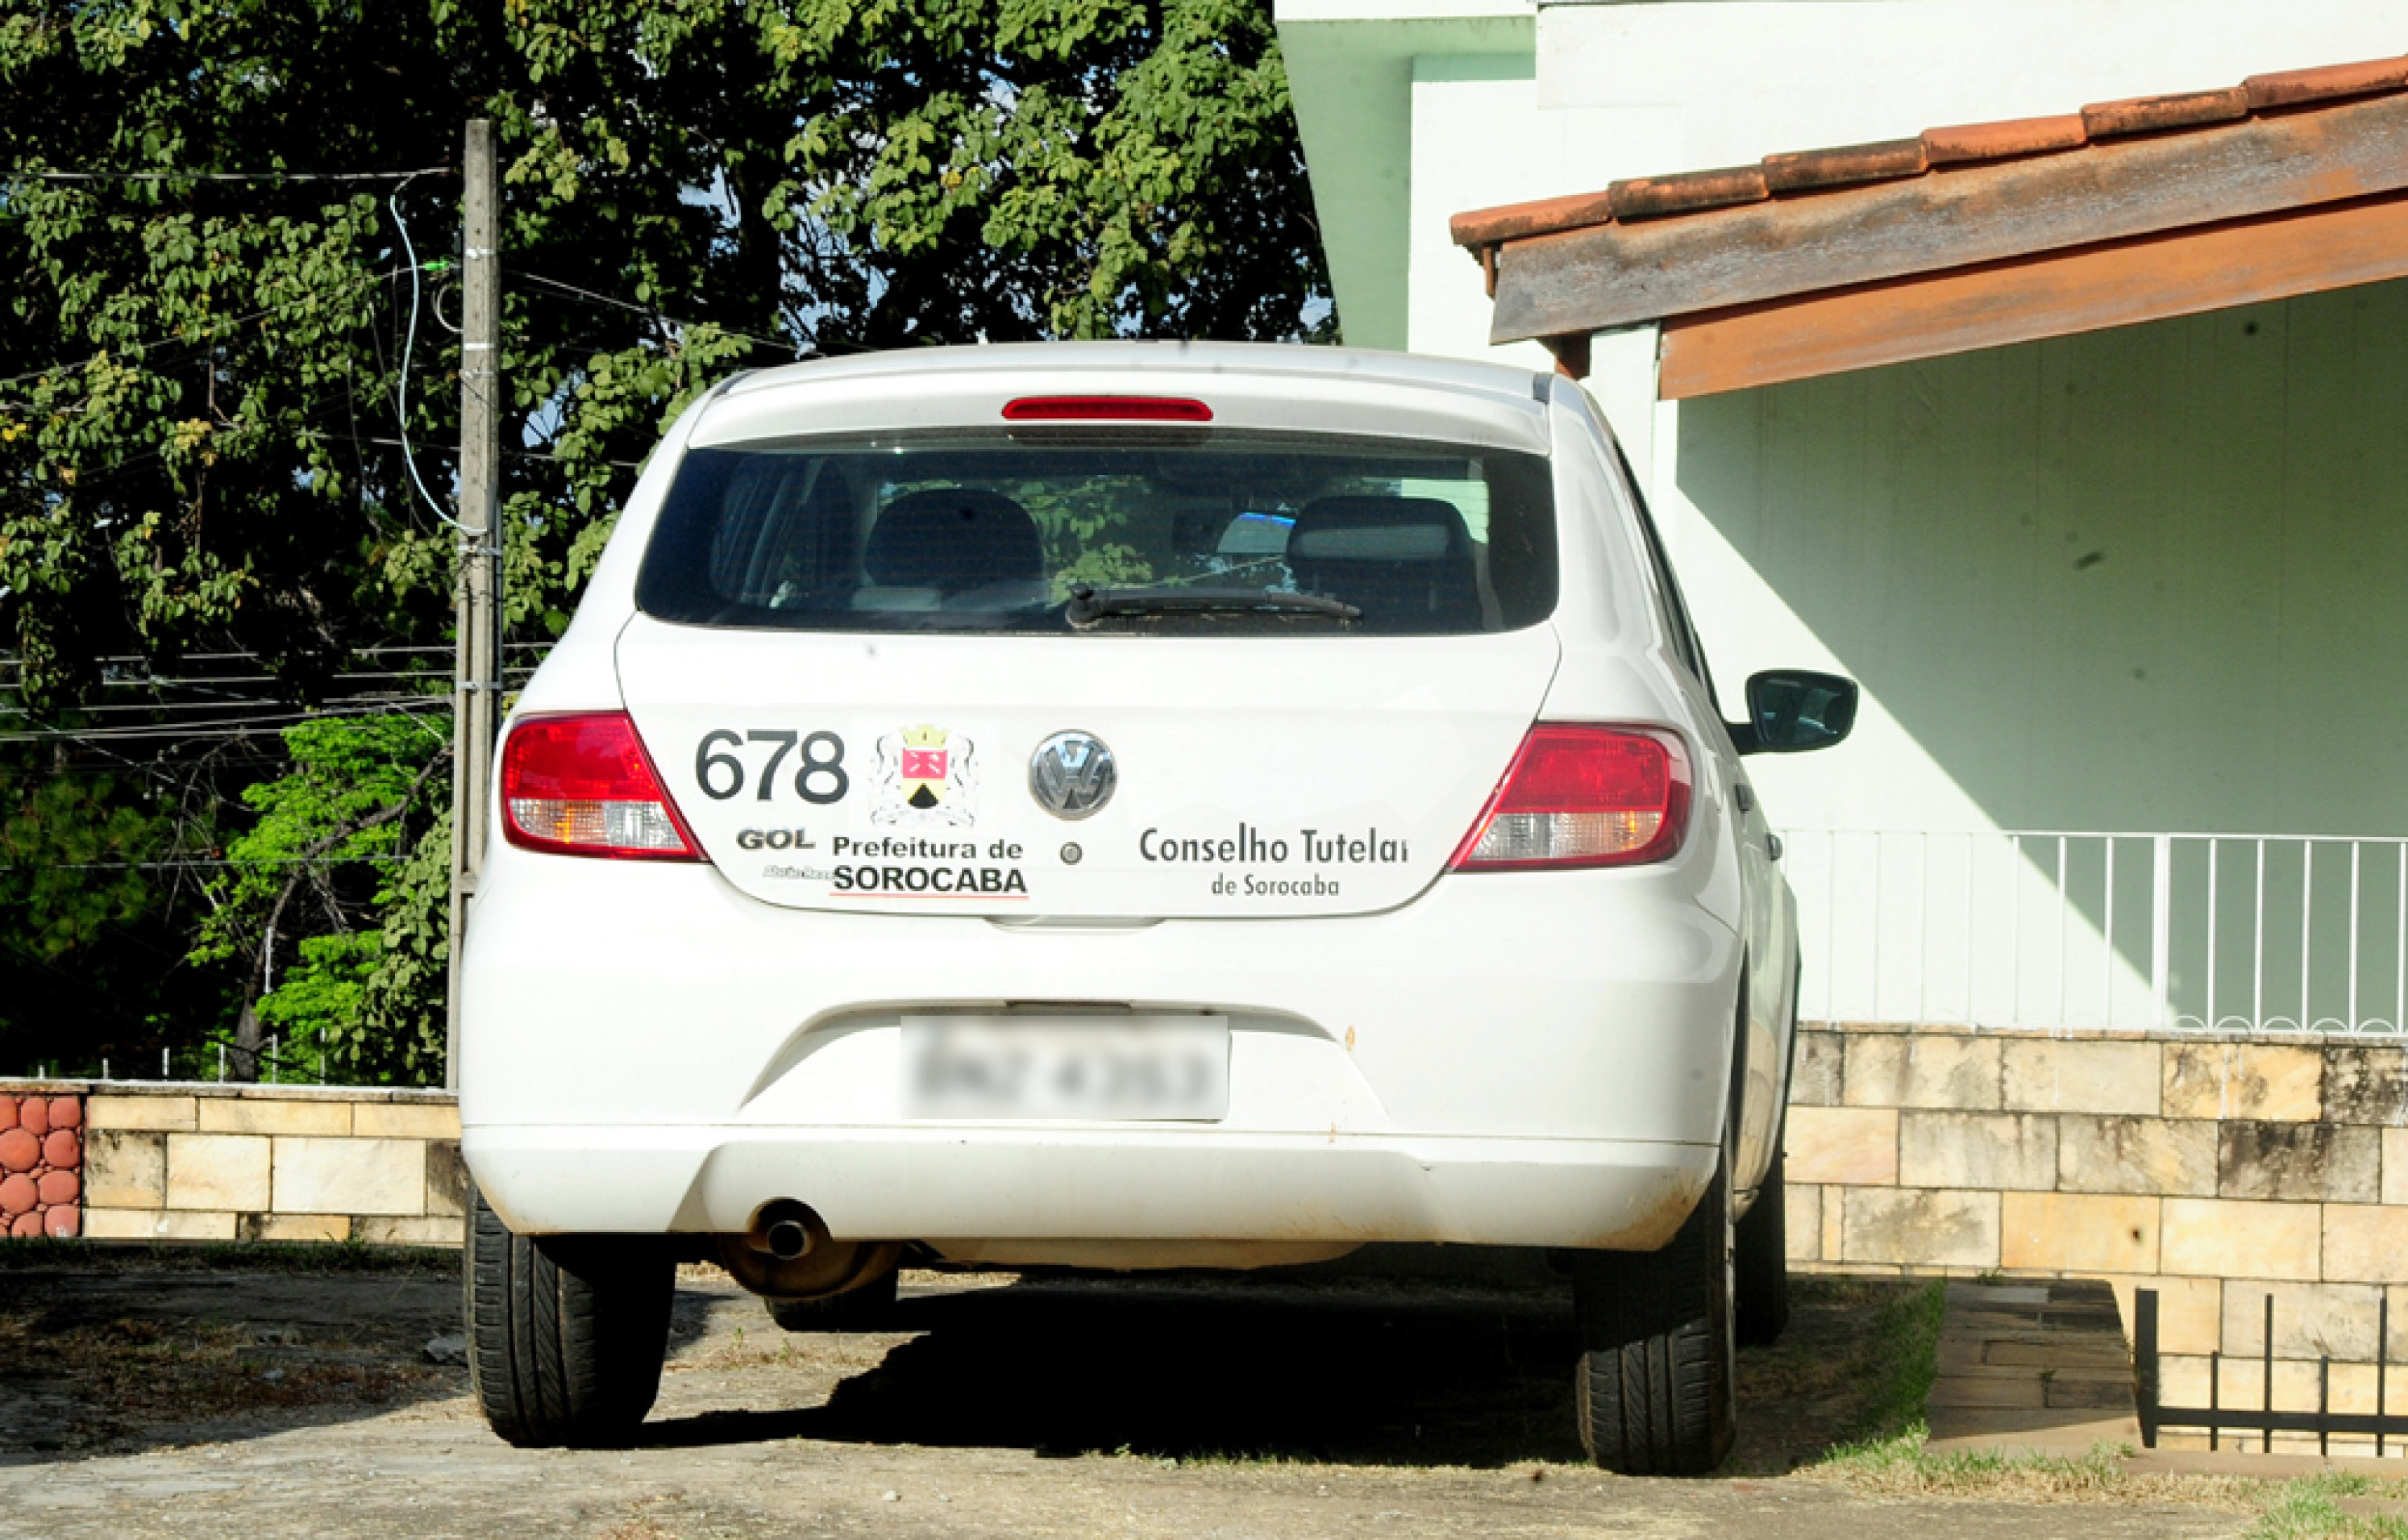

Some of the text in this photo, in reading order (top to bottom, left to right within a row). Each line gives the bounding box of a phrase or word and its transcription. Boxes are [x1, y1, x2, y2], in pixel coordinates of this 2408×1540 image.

[696, 729, 849, 805] 678
[736, 828, 816, 851] GOL
[833, 837, 1023, 859] Prefeitura de
[1140, 822, 1289, 863] Conselho
[833, 865, 1028, 893] SOROCABA
[1211, 872, 1339, 896] de Sorocaba
